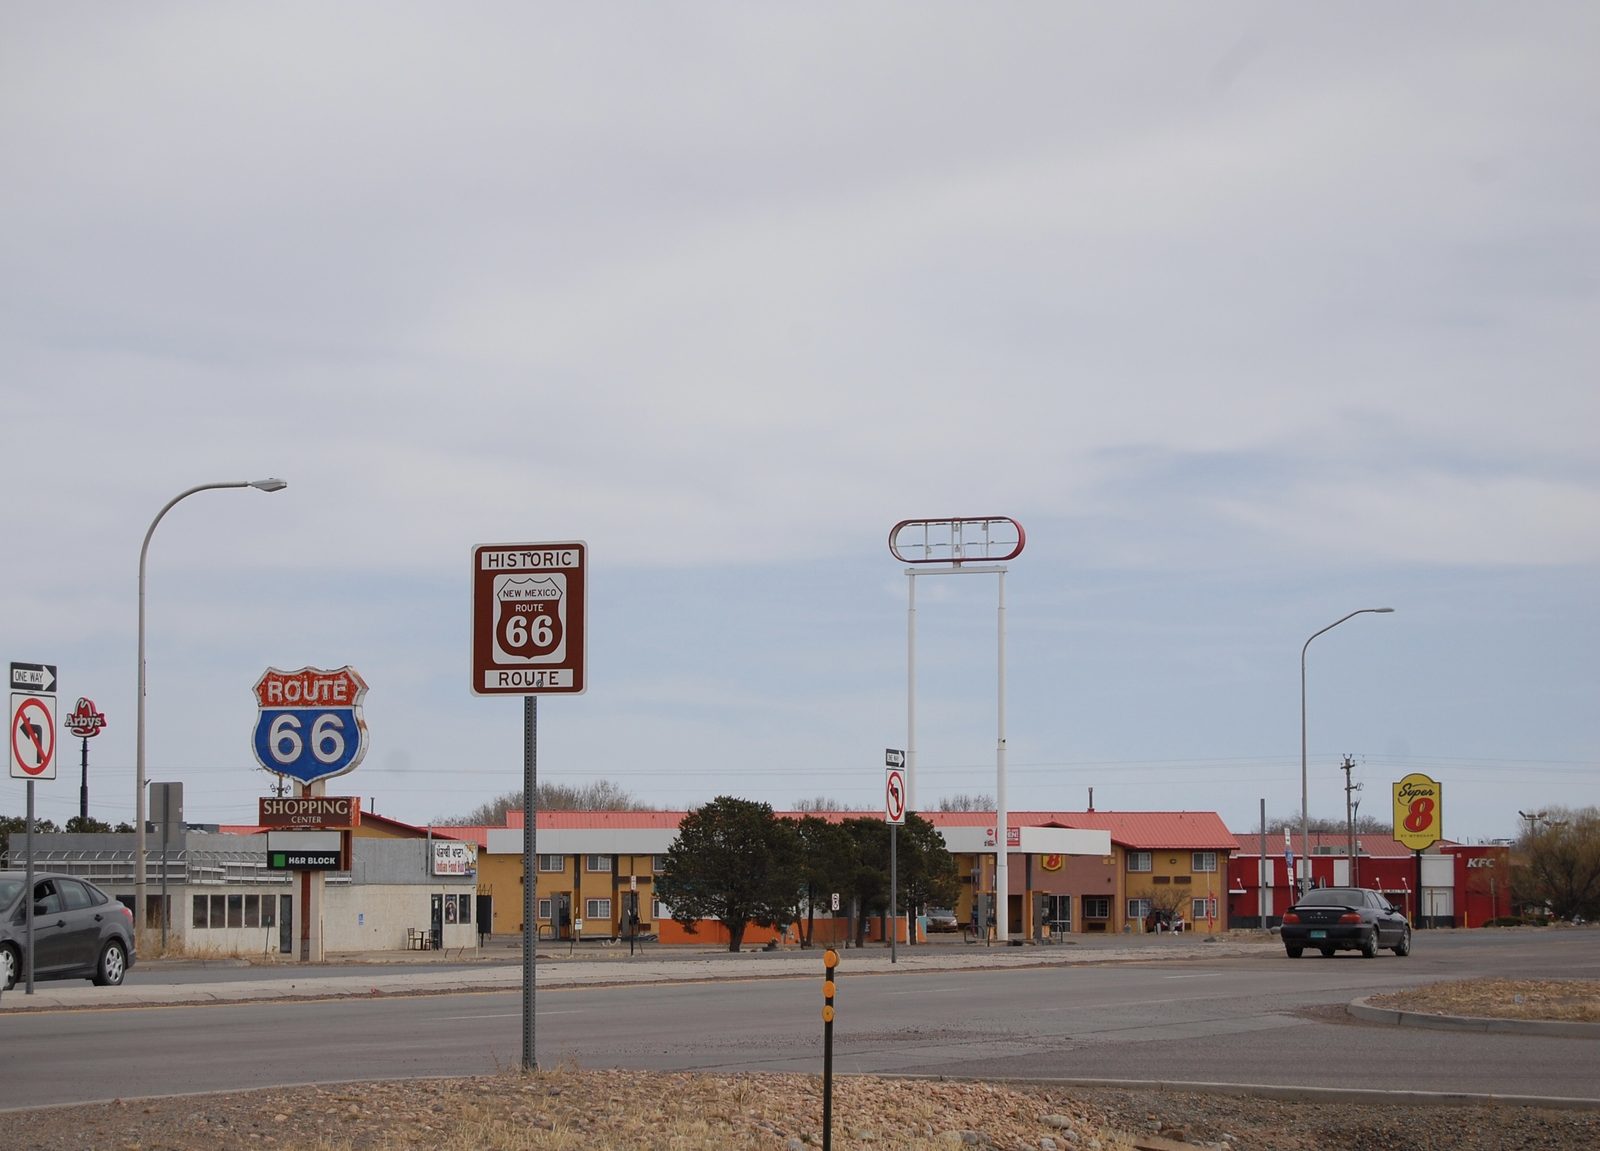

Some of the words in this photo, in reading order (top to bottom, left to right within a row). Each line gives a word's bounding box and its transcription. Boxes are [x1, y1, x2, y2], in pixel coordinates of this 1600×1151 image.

[488, 551, 572, 568] HISTORIC
[503, 589, 522, 598] NEW
[525, 588, 557, 597] MEXICO
[515, 603, 544, 612] ROUTE
[506, 614, 553, 648] 66
[15, 670, 27, 682] ONE
[29, 672, 43, 683] WAY
[499, 671, 559, 686] ROUTE
[267, 678, 347, 702] ROUTE
[64, 713, 102, 729] Arby's
[269, 713, 345, 763] 66
[1398, 783, 1435, 804] Super
[263, 800, 348, 815] SHOPPING
[1403, 797, 1435, 833] 8
[291, 815, 322, 824] CENTER
[288, 857, 306, 865] H&R
[307, 857, 336, 865] BLOCK
[1467, 858, 1496, 868] KFC
